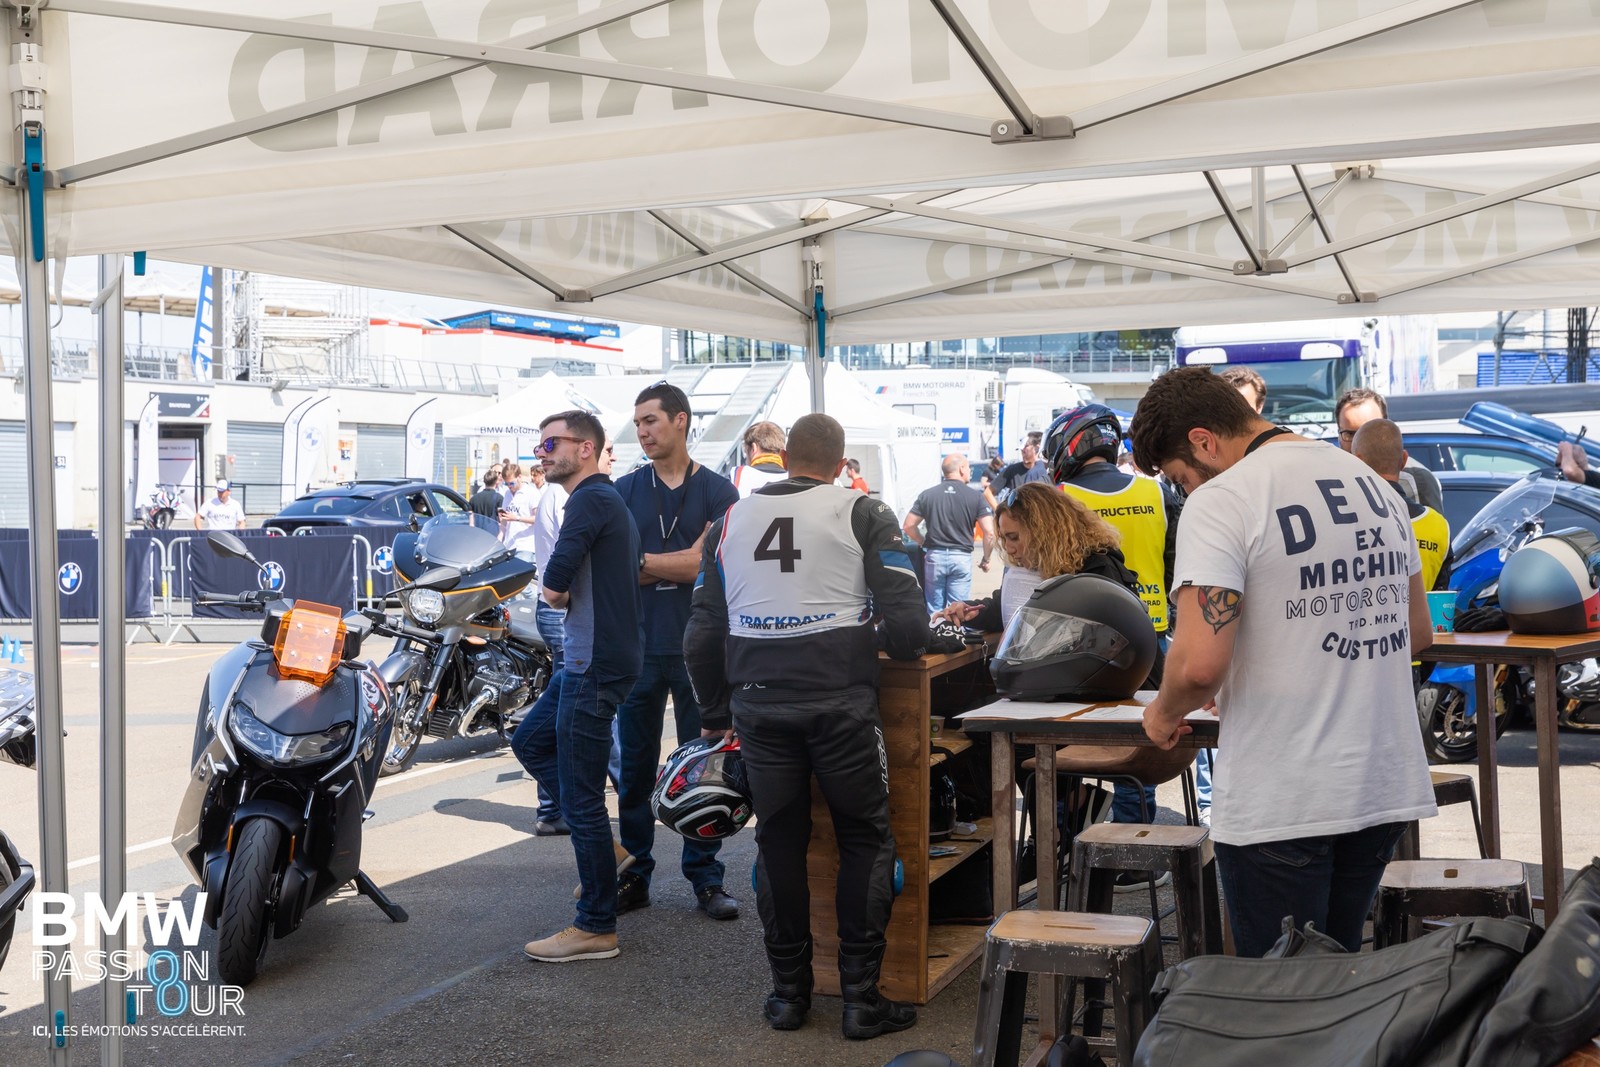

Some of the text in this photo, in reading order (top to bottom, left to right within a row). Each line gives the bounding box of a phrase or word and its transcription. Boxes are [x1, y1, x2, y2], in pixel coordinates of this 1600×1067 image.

[922, 381, 965, 389] MOTORRAD
[480, 426, 541, 435] BMW Motorra
[1093, 505, 1155, 518] TRUCTEUR
[754, 517, 801, 573] 4
[1355, 527, 1386, 551] EX
[1137, 584, 1160, 594] AYS
[1286, 583, 1409, 619] MOTORCYC
